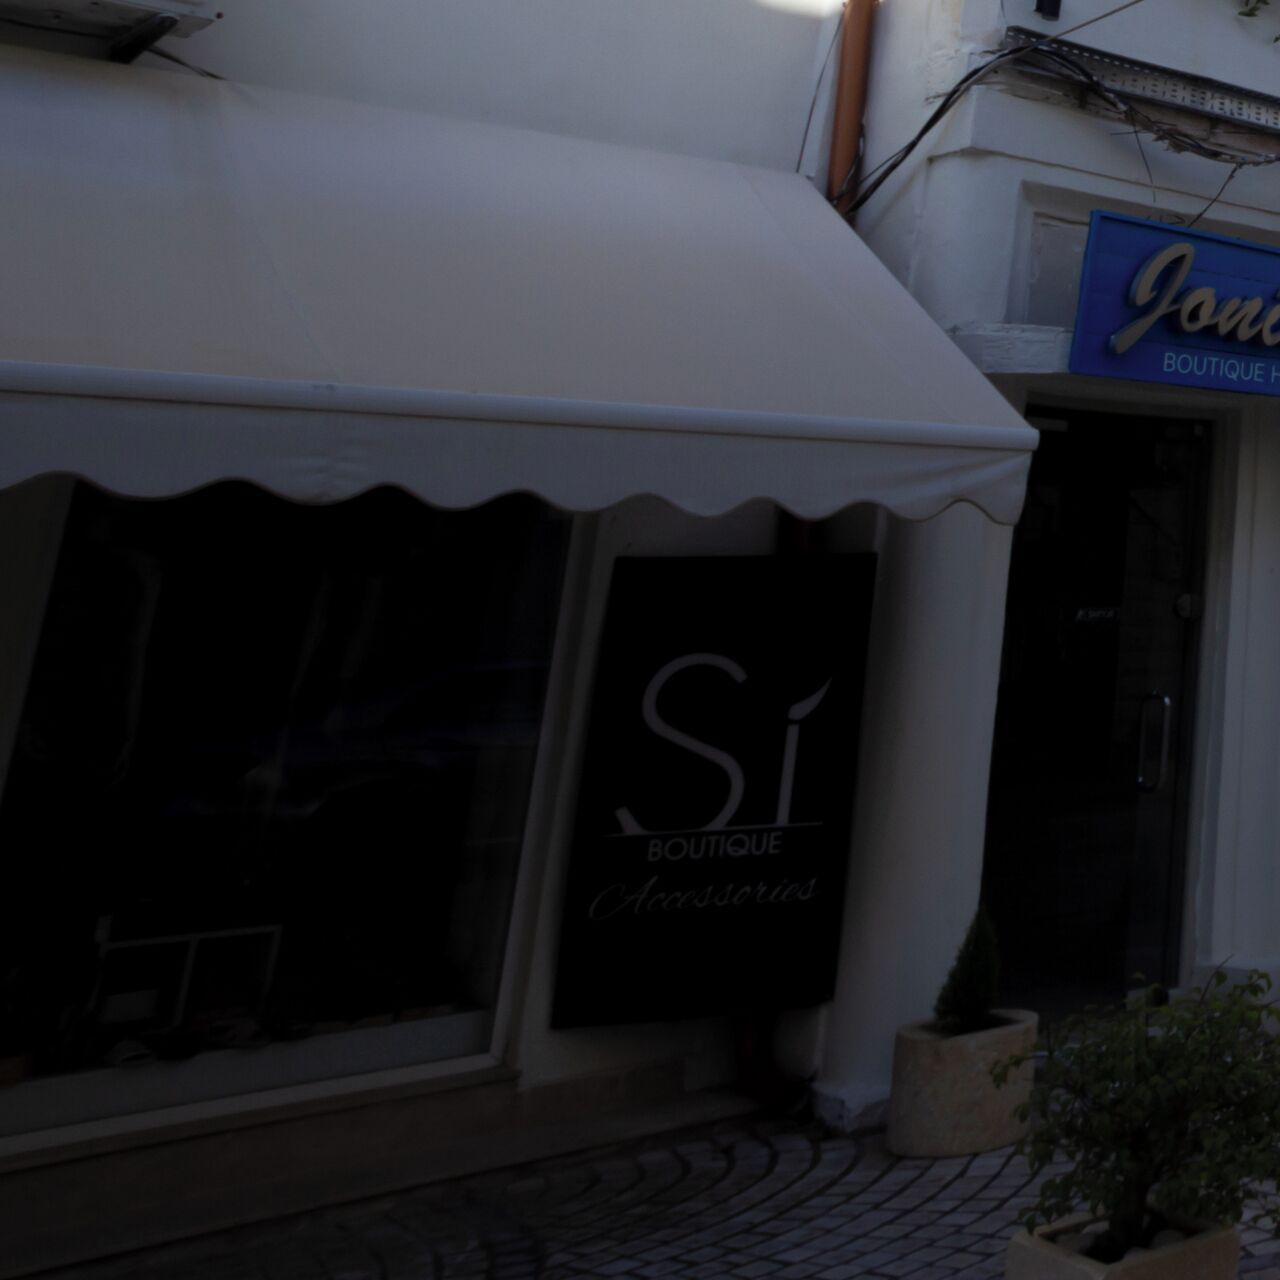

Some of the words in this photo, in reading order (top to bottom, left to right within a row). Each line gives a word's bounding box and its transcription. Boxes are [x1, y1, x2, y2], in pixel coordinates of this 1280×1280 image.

[1162, 351, 1265, 382] BOUTIQUE
[647, 831, 783, 863] BOUTIQUE
[588, 874, 818, 920] Accessories
